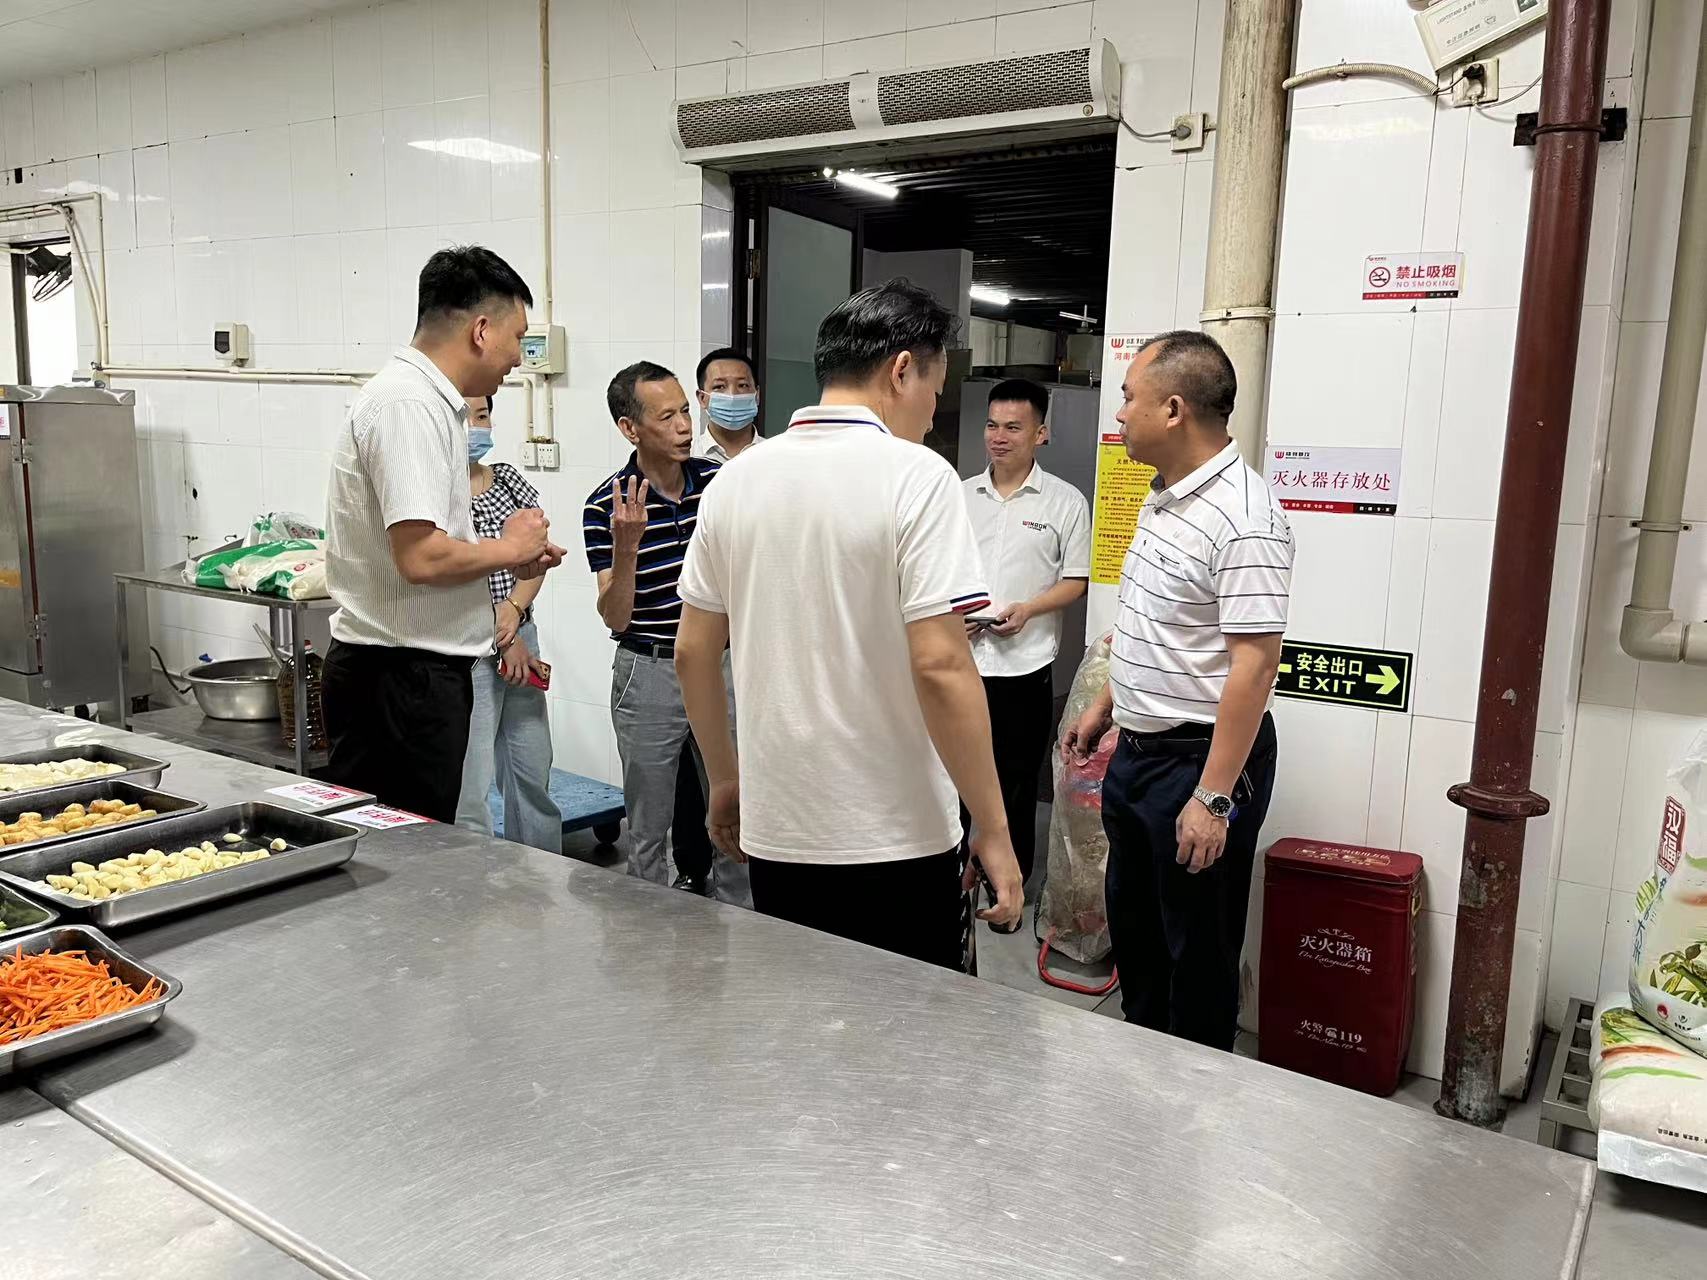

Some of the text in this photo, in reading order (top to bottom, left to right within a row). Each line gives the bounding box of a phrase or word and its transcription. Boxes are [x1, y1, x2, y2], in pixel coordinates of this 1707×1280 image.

[1396, 264, 1456, 280] 禁止吸烟
[1412, 279, 1456, 288] SMOKING
[1271, 470, 1391, 491] 灭火器存放处
[1296, 652, 1363, 677] 安全出口
[1298, 675, 1357, 695] EXIT
[1299, 934, 1373, 963] 灭火器箱
[1340, 1031, 1362, 1044] 119
